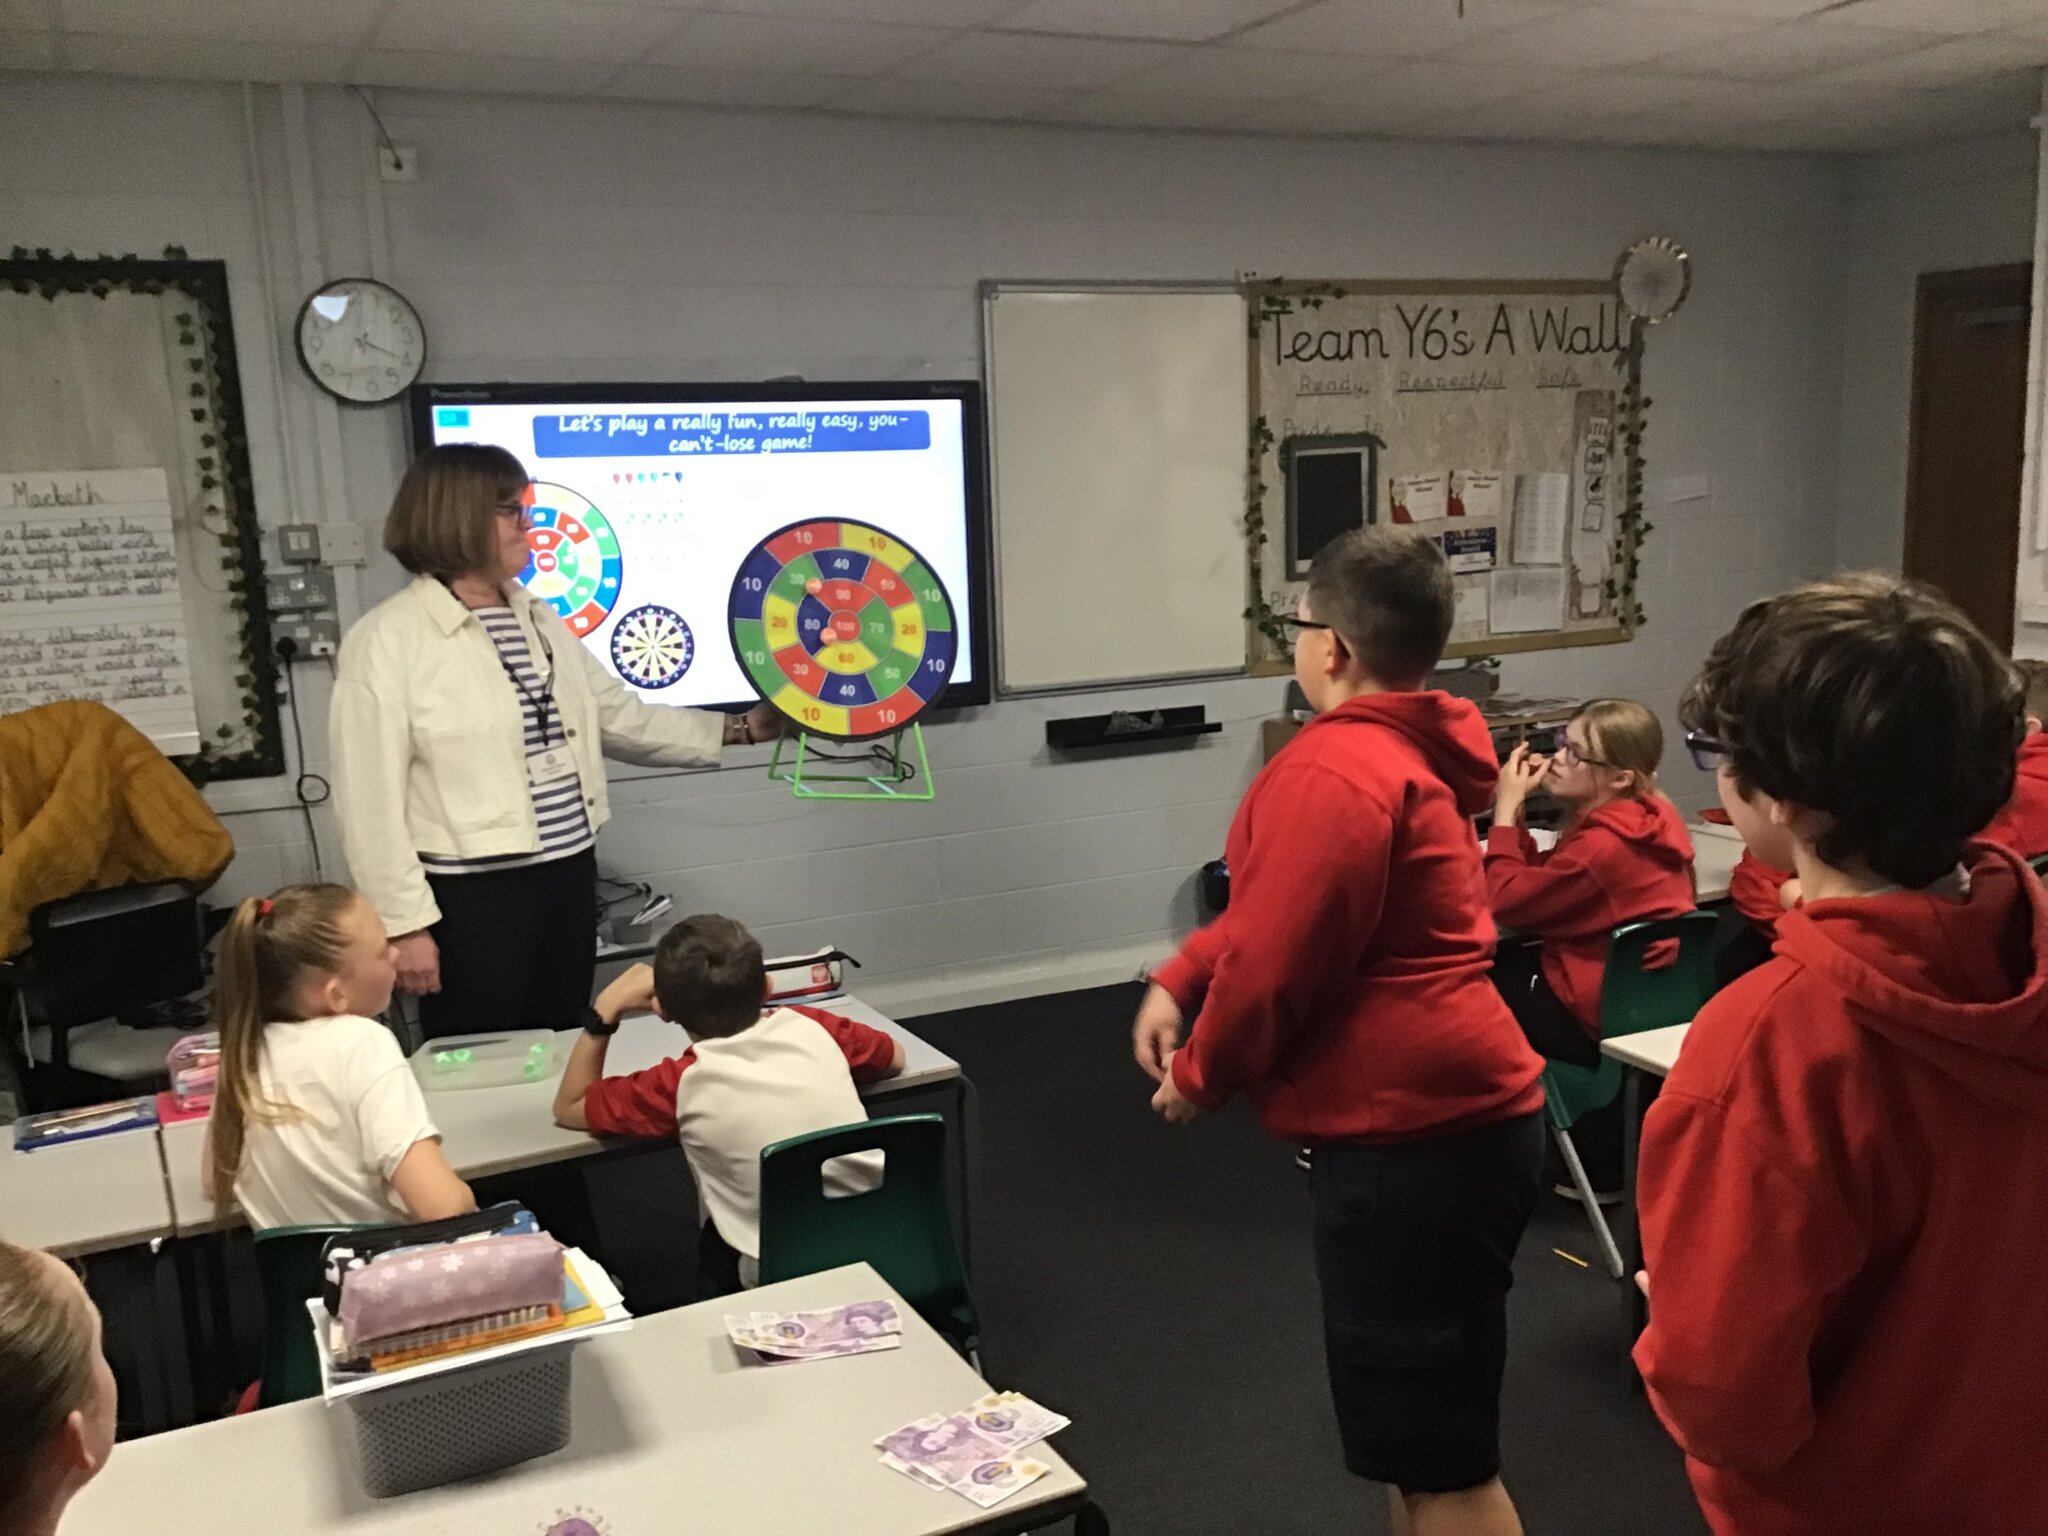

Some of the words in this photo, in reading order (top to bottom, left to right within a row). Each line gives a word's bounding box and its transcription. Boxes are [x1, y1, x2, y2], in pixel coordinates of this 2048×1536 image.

[1265, 310, 1390, 366] Team
[1396, 303, 1475, 361] Y6's
[1485, 302, 1515, 356] A
[1529, 299, 1627, 355] Wall
[559, 415, 603, 432] Let's
[608, 414, 648, 437] play
[654, 419, 666, 431] a
[672, 413, 721, 434] really
[727, 412, 764, 431] fun,
[769, 411, 816, 432] really
[821, 413, 864, 432] easy,
[869, 414, 909, 431] you-
[669, 435, 755, 453] can't-lose
[761, 434, 813, 454] game!
[794, 531, 813, 545] 10
[868, 536, 887, 550] 10
[834, 558, 850, 570] 40
[742, 577, 762, 592] 10
[923, 589, 941, 602] 10
[772, 617, 788, 628] 20
[869, 622, 885, 634] 70
[901, 624, 917, 635] 20
[745, 651, 765, 665] 10
[792, 663, 809, 676] 30
[926, 659, 946, 673] 10
[884, 668, 901, 679] 50
[839, 684, 856, 696] 40
[802, 708, 820, 721] 10
[877, 710, 896, 723] 10
